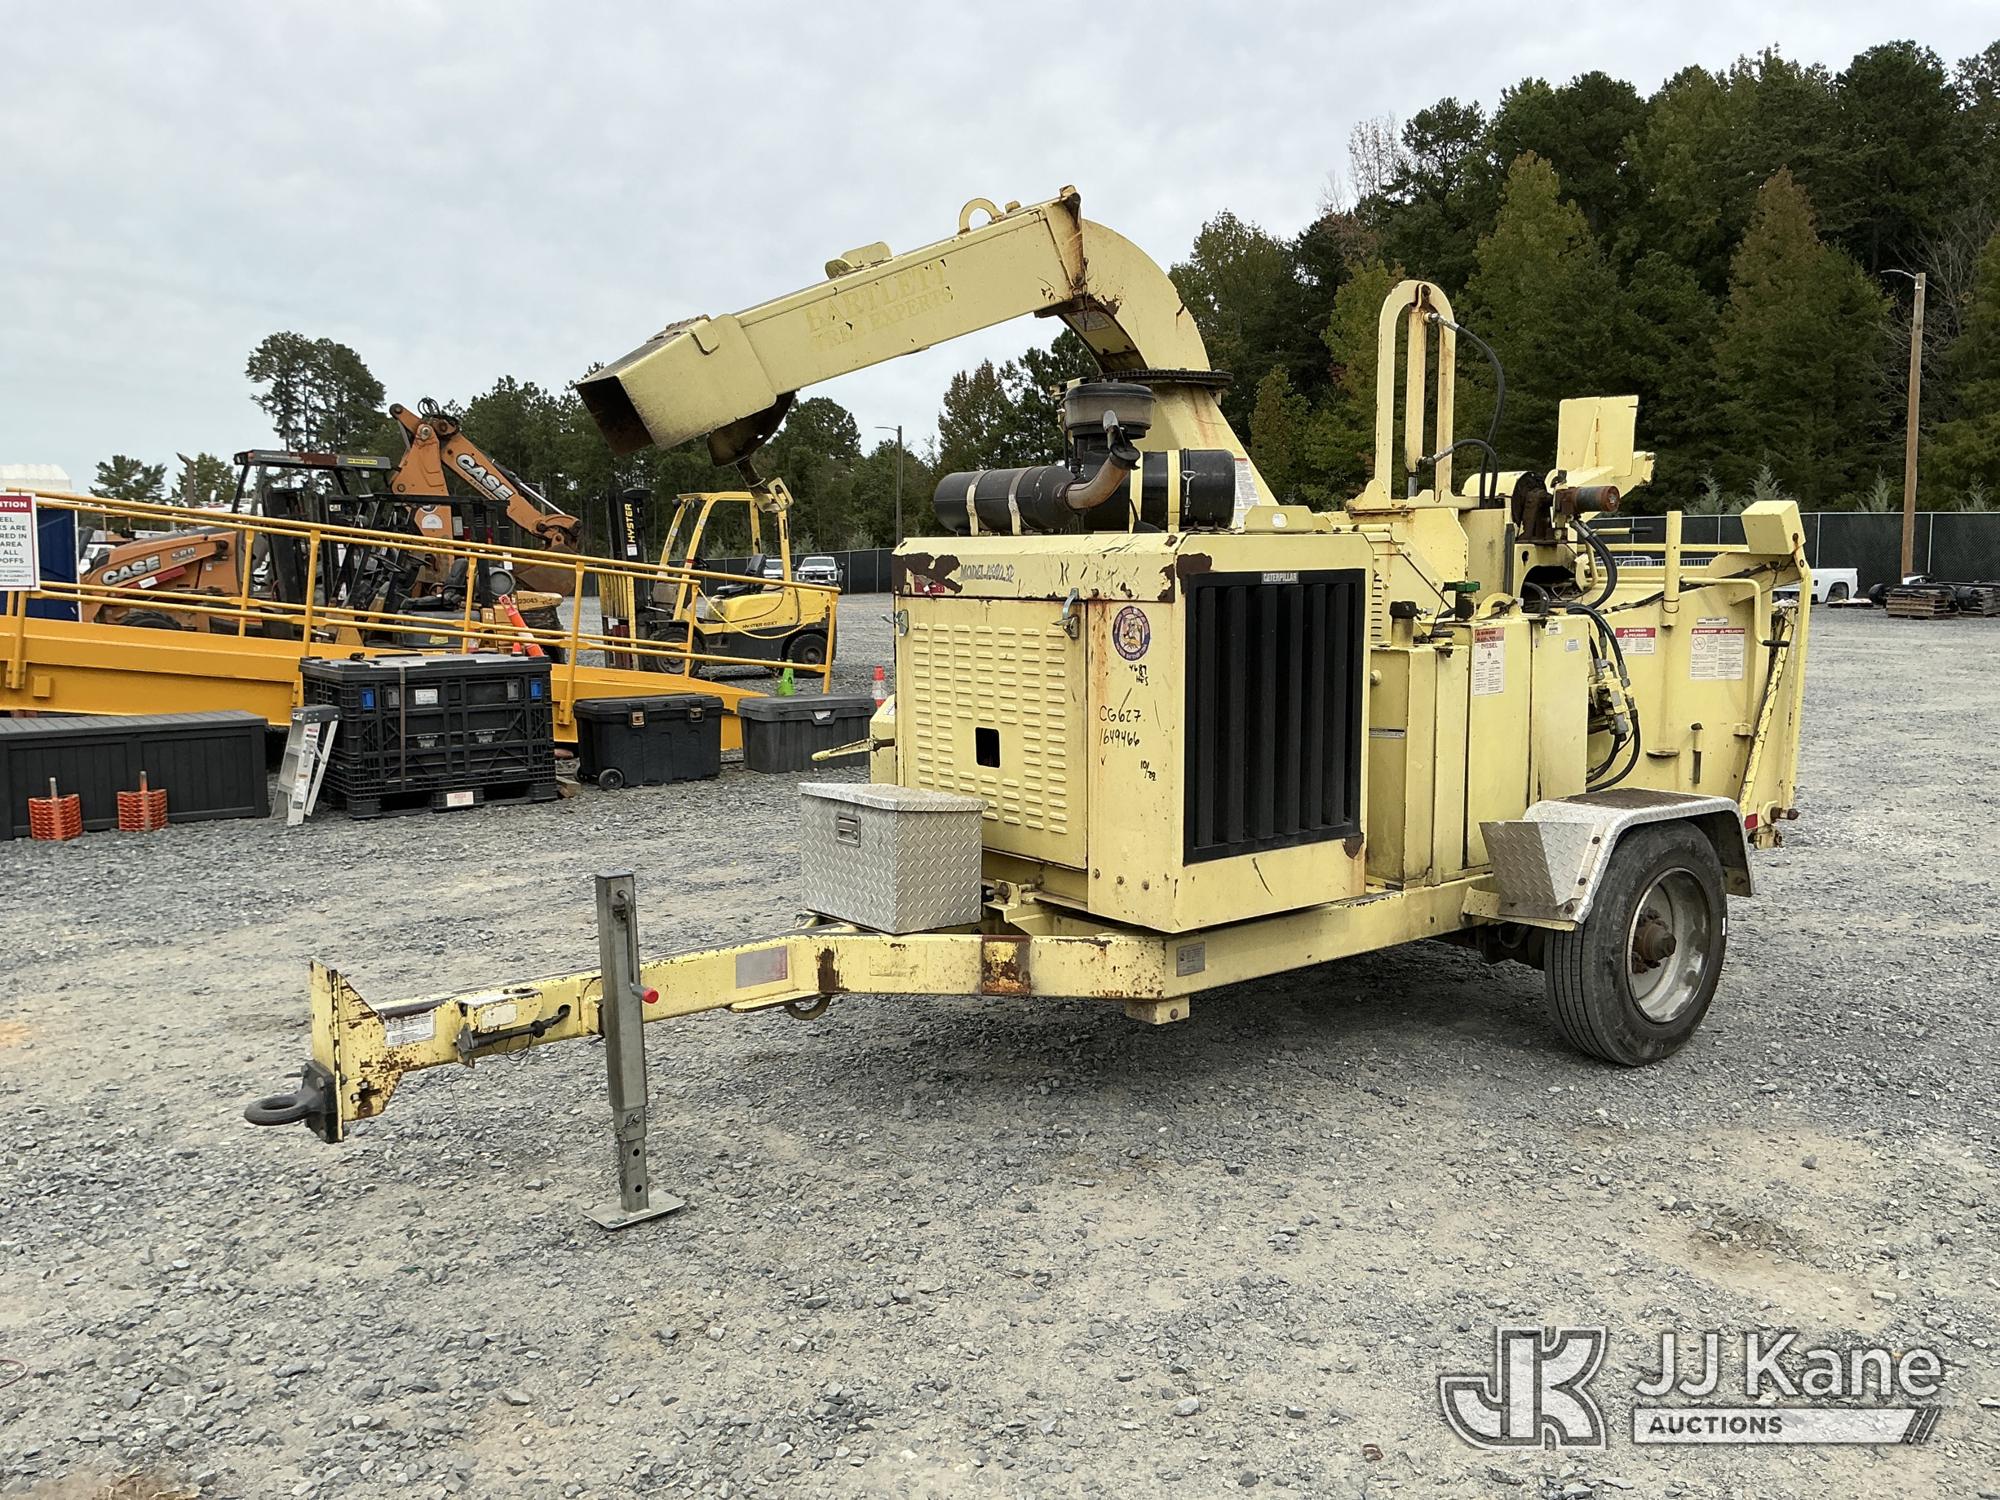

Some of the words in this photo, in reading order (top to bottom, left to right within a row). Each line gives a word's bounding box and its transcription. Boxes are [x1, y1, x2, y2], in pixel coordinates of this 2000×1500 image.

[457, 454, 514, 501] CASE
[624, 503, 636, 543] HYSTER
[102, 555, 160, 585] CASE
